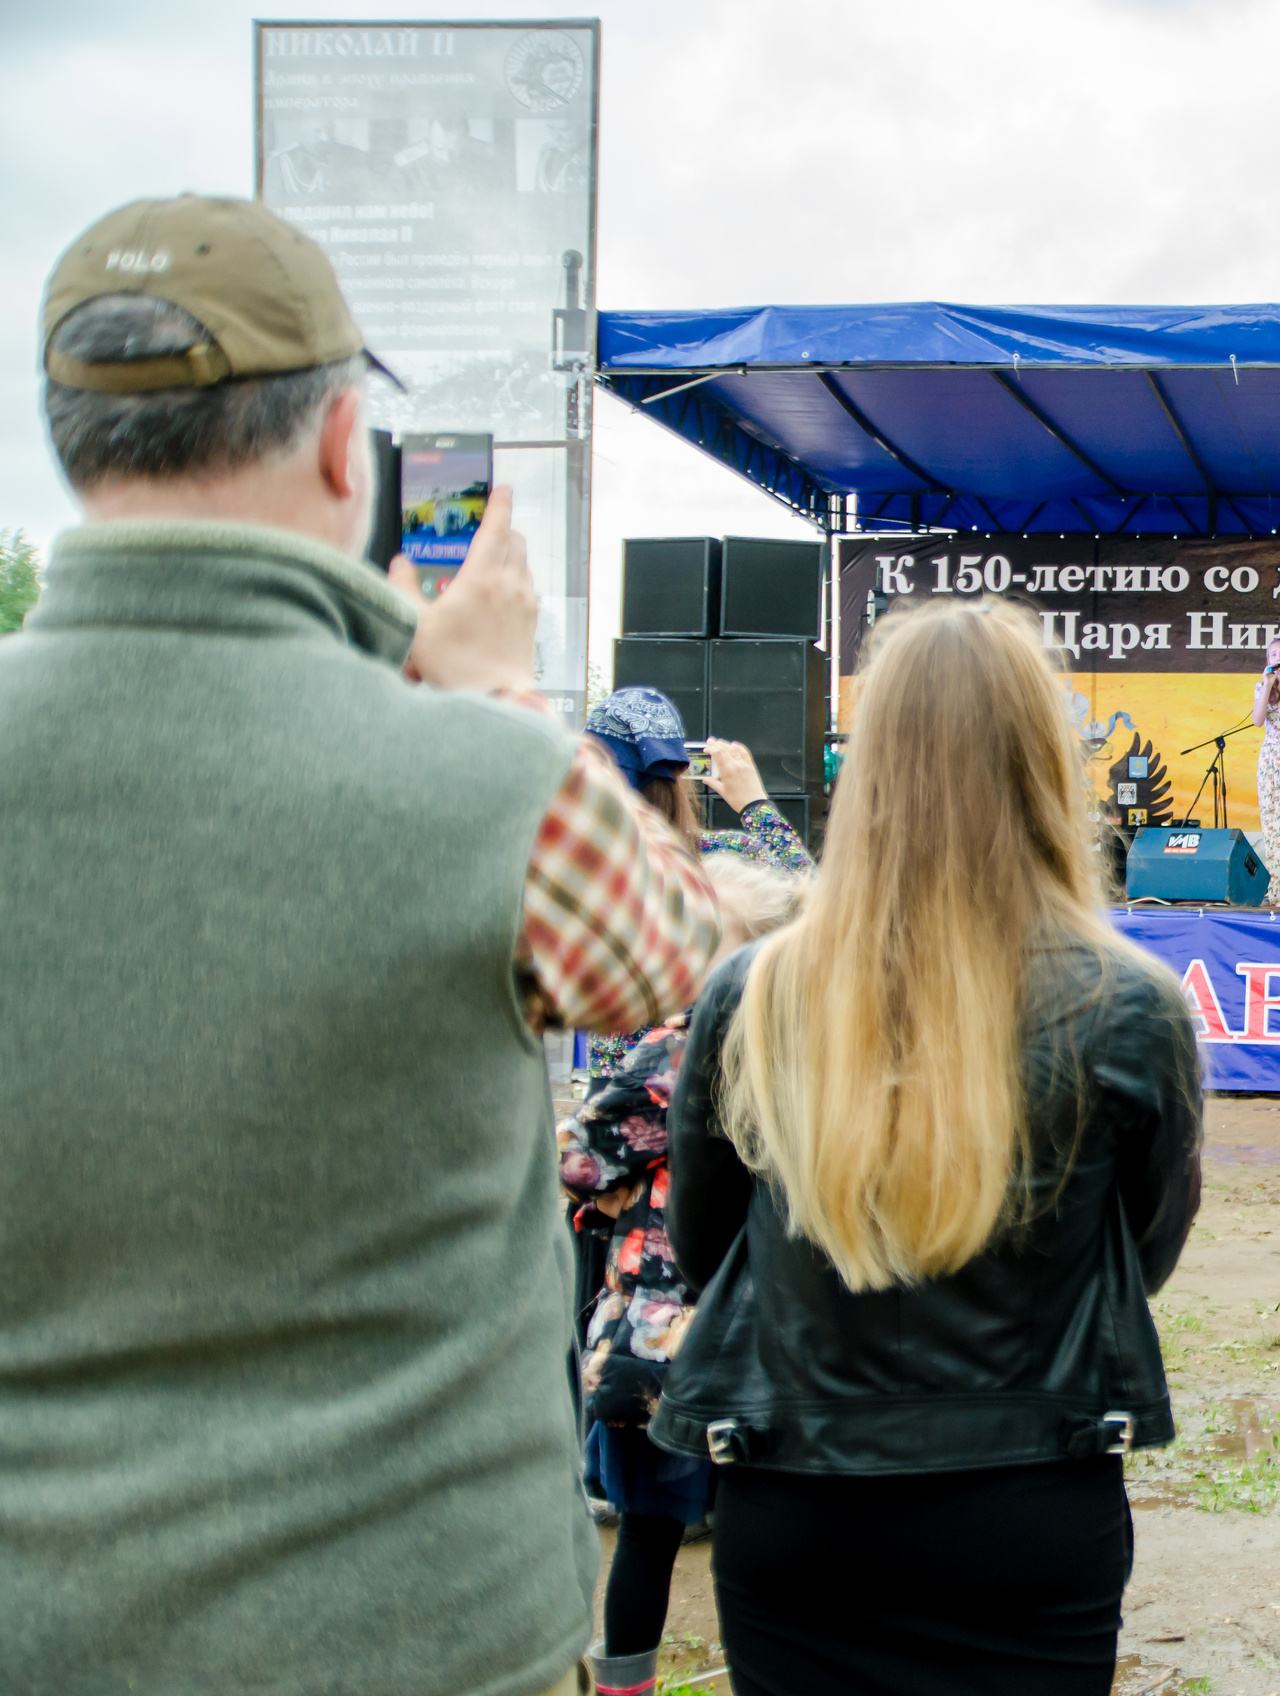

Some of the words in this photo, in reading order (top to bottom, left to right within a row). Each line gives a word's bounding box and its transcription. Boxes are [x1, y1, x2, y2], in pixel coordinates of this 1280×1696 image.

[266, 28, 419, 57] НИКОЛАЙ
[105, 249, 170, 273] POLO
[875, 555, 914, 594] К
[931, 555, 1190, 594] 150-летию
[1203, 565, 1260, 593] со
[1039, 611, 1172, 659] Царя
